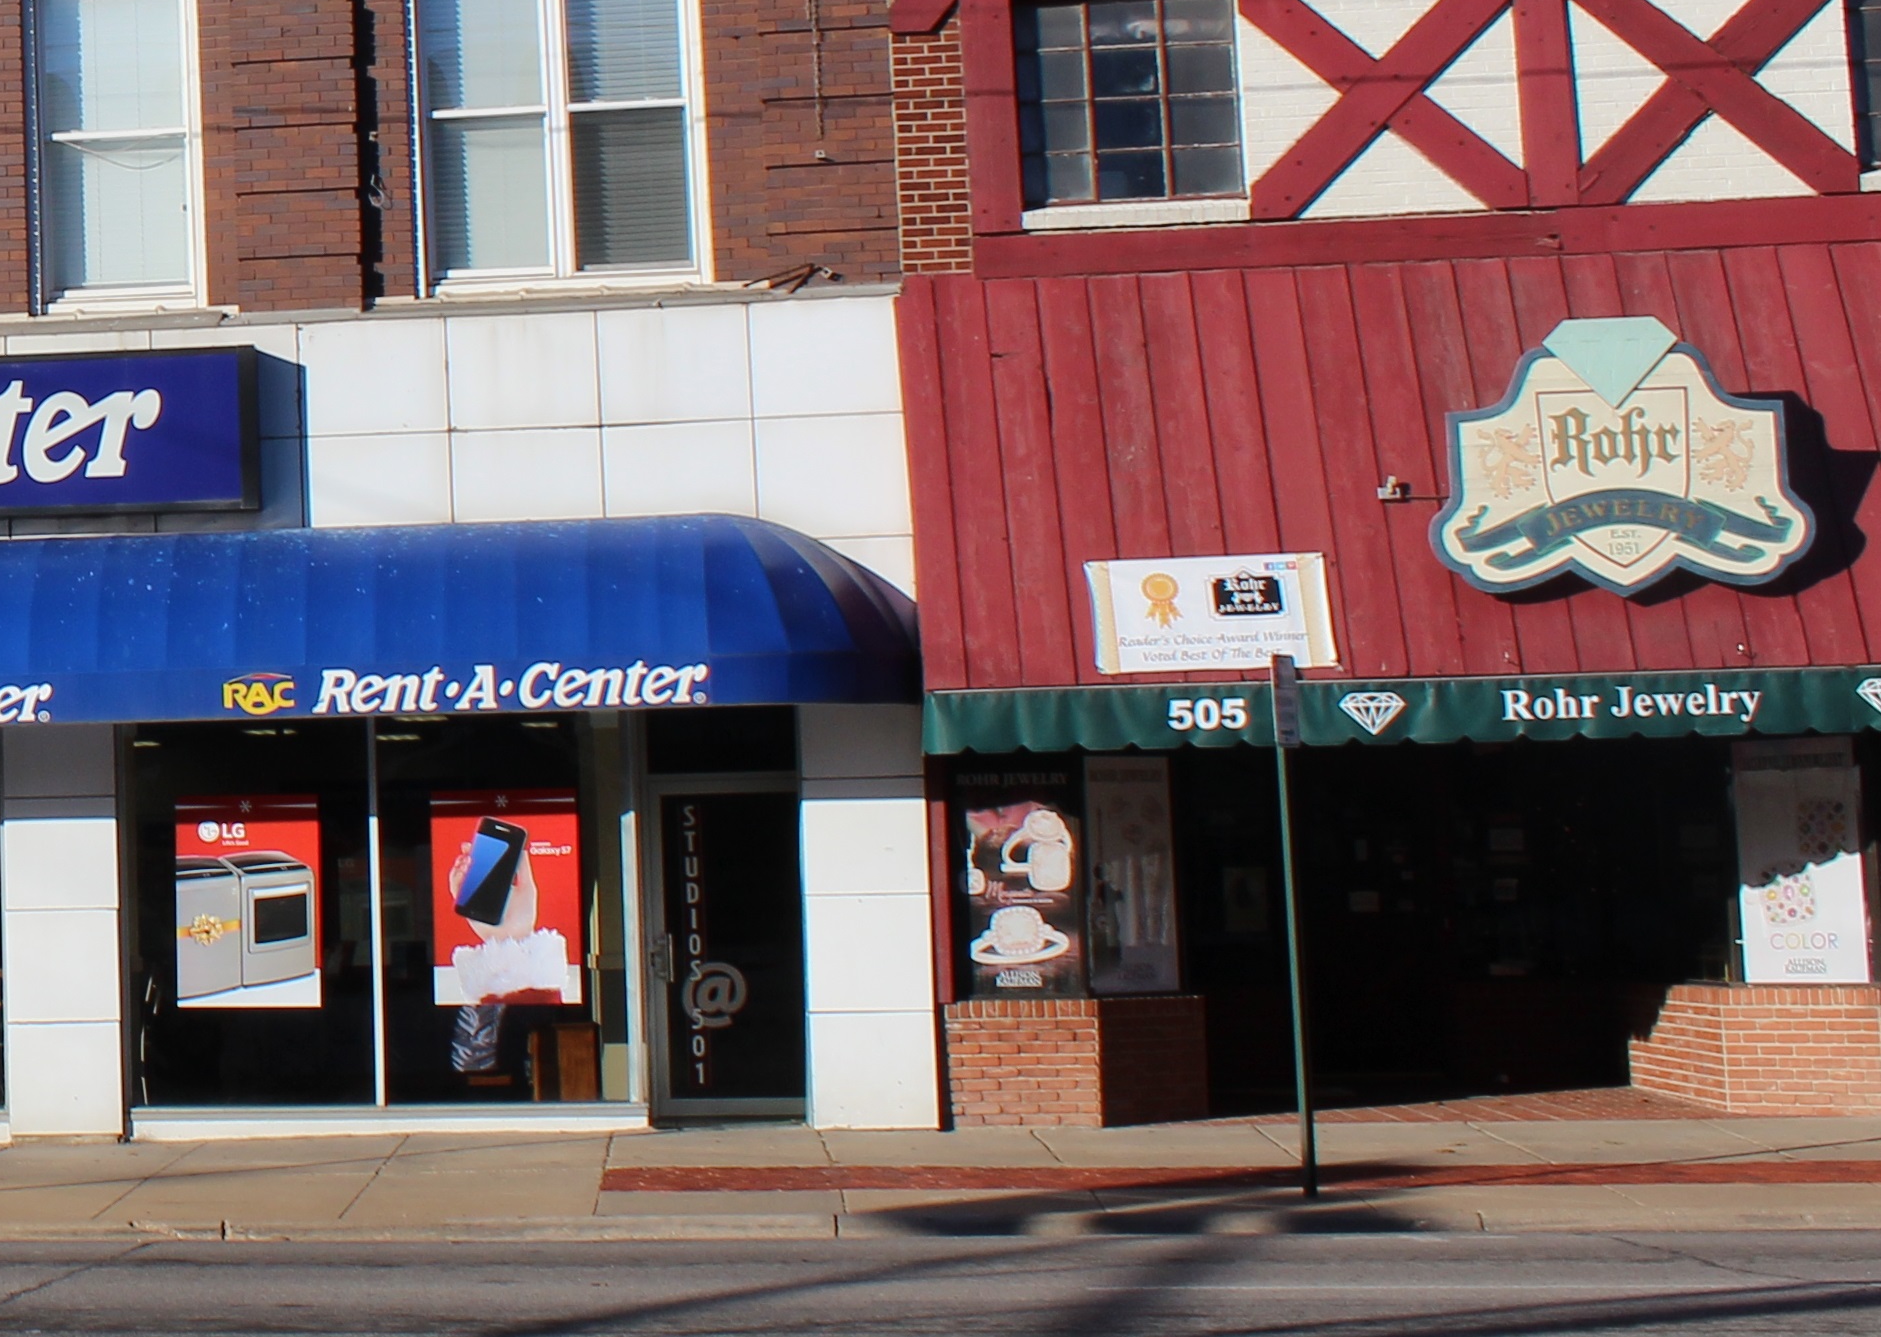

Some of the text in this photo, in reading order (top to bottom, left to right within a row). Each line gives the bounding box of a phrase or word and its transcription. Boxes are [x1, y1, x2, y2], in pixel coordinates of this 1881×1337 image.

[1548, 407, 1680, 478] Rohr
[1546, 498, 1704, 536] JEWELRY
[1610, 528, 1641, 540] EST.
[1607, 542, 1641, 556] 1951
[1223, 577, 1266, 591] Rohr
[1218, 601, 1280, 613] JEWELRY
[1119, 630, 1307, 648] Reader's Choice Award Winner
[1142, 650, 1176, 662] Voted
[1181, 650, 1207, 661] Best
[1212, 649, 1227, 661] Of
[1230, 648, 1250, 659] The
[224, 680, 295, 715] RAC
[1501, 684, 1762, 723] Rohr Jewelry
[1168, 698, 1248, 731] 505
[956, 771, 1069, 787] ROHR JEWELRY
[221, 822, 246, 839] LG
[530, 845, 572, 856] Galaxy S7
[683, 805, 702, 981] STUDIOS
[1770, 932, 1838, 950] COLOR
[691, 1008, 705, 1084] 501
